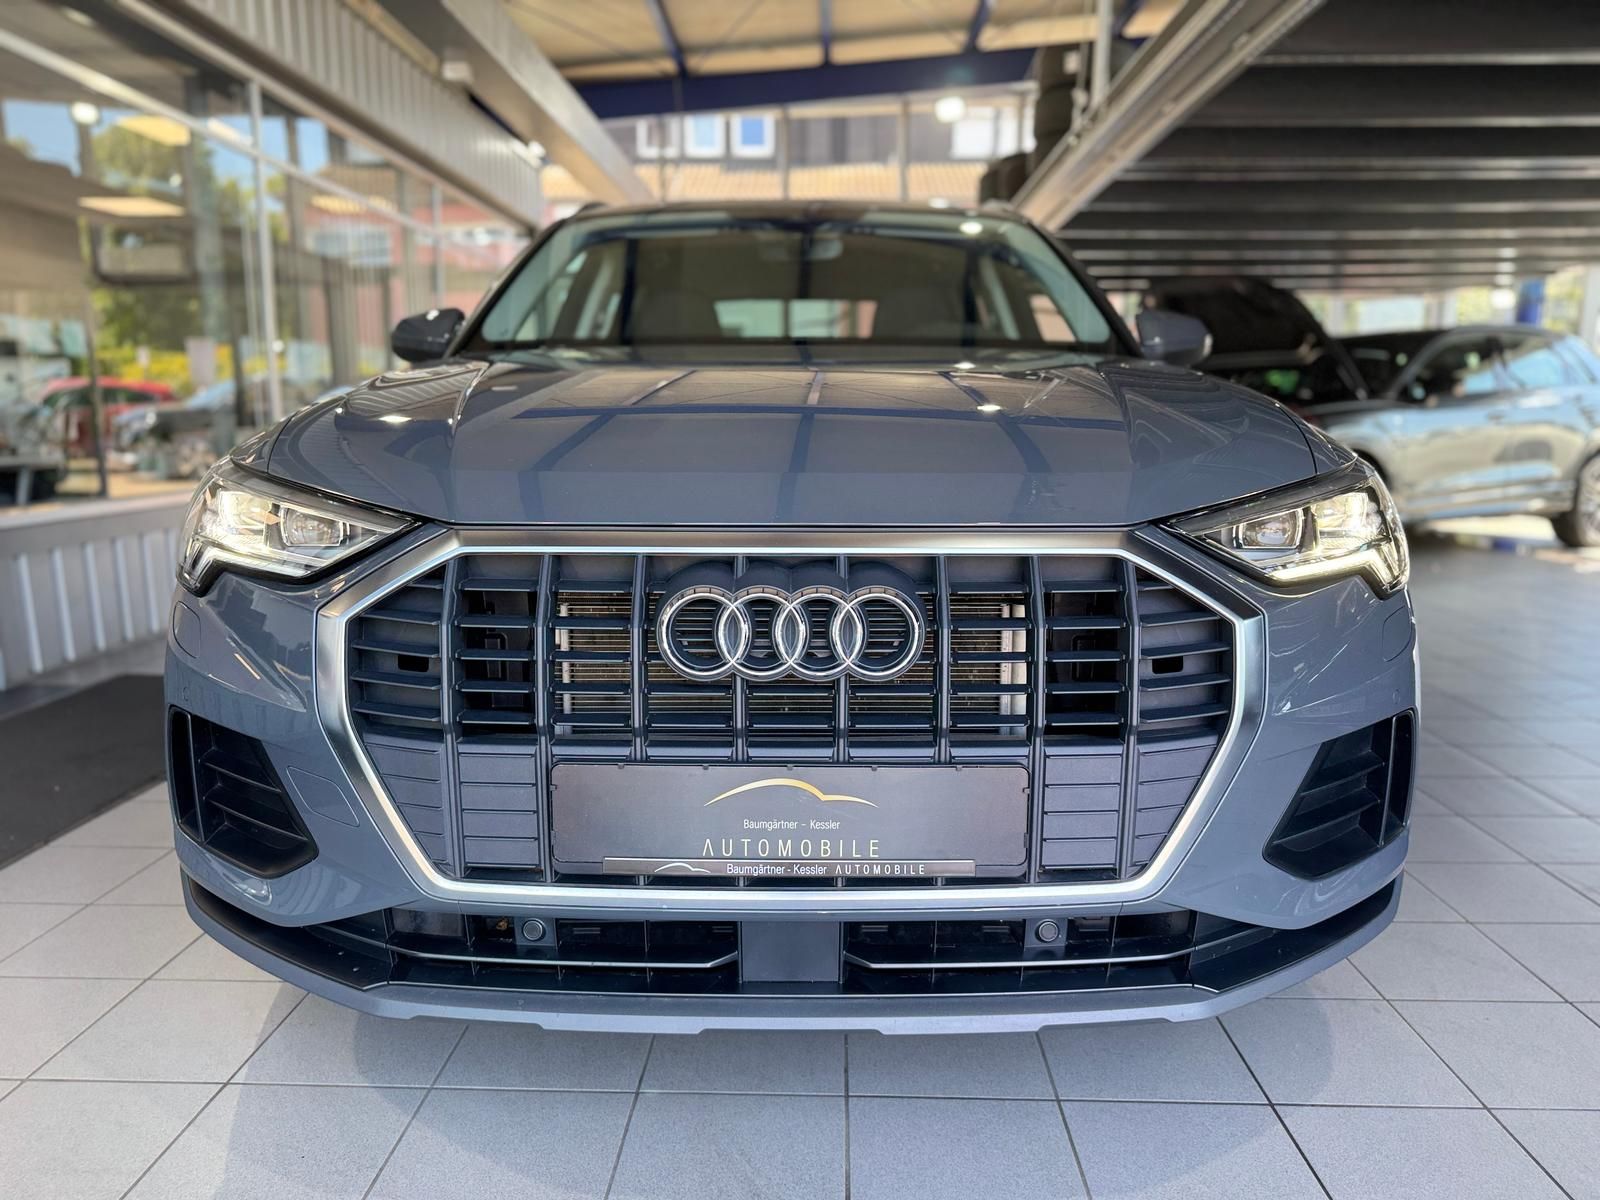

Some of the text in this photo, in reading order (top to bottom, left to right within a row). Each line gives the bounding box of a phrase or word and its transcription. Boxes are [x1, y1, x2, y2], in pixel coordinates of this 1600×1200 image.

[743, 818, 798, 831] Baumgärtner
[810, 819, 840, 830] Kessler
[702, 838, 880, 857] AUTOMOBILE
[726, 863, 785, 876] Baumgärtner
[793, 863, 827, 875] Kessler
[835, 864, 925, 875] AUTOMOBILE
